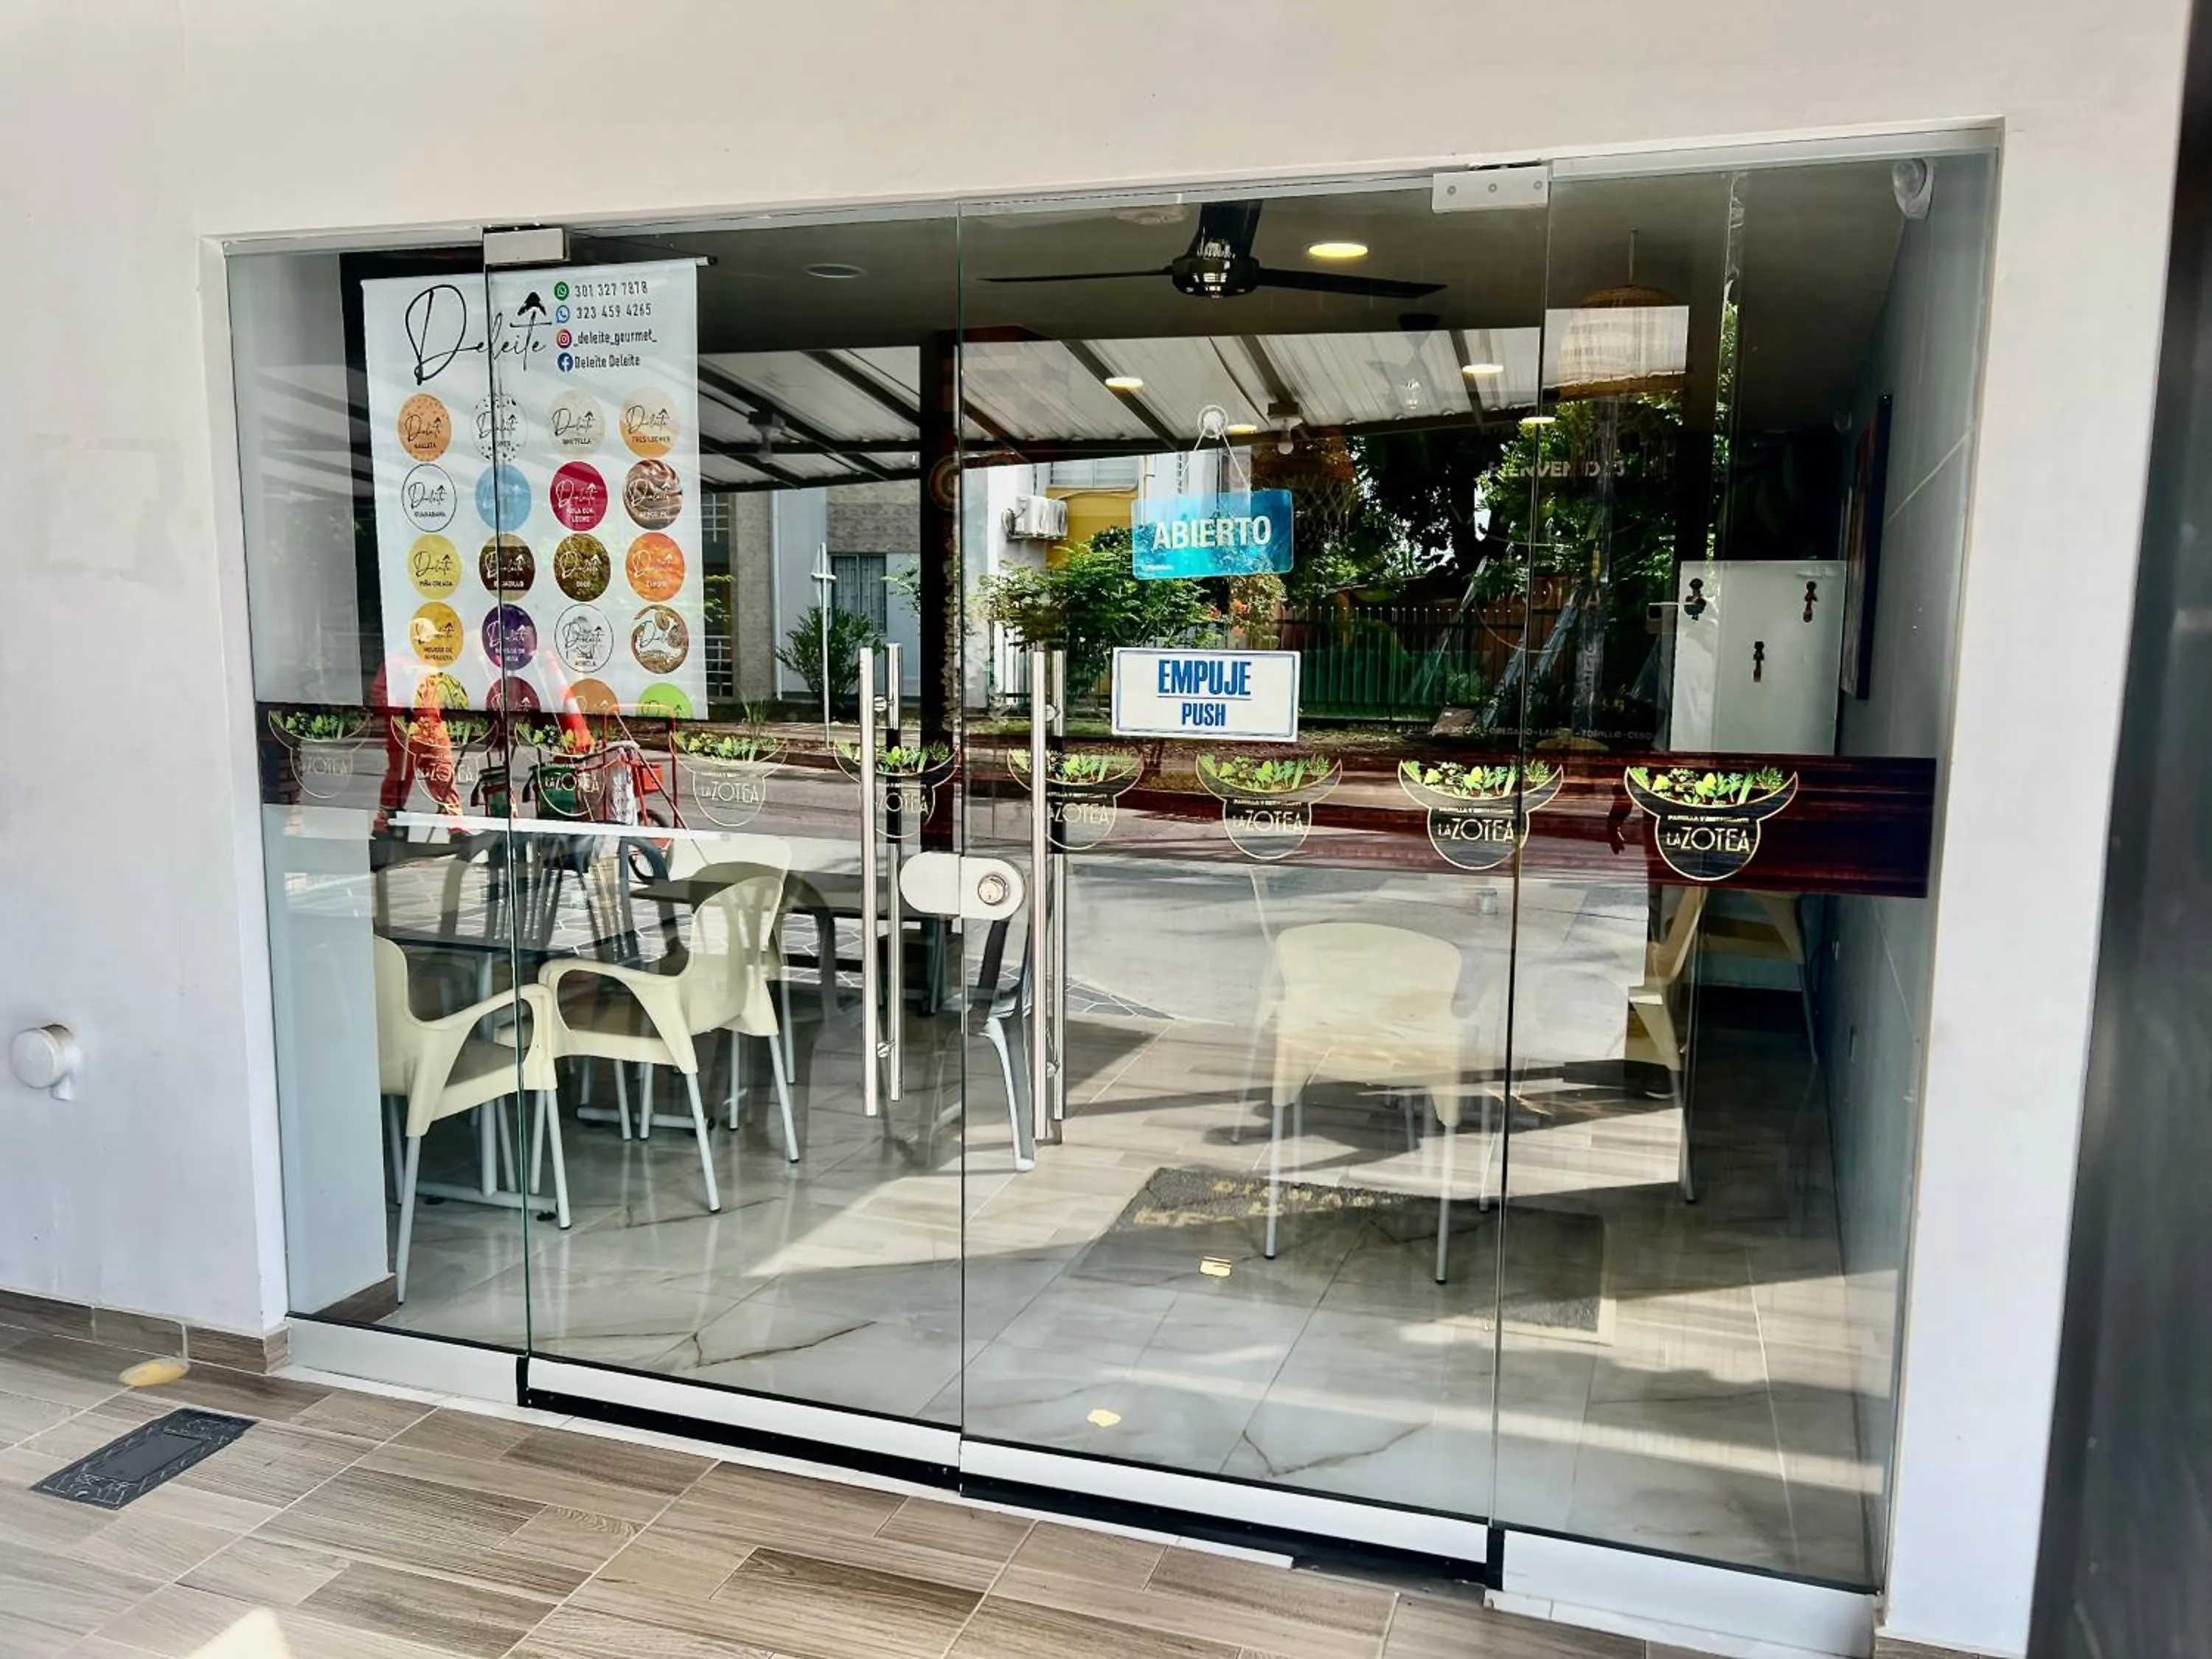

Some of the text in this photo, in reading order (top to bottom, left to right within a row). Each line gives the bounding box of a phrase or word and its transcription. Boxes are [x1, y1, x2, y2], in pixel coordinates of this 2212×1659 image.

[575, 284, 594, 297] 301
[598, 282, 616, 296] 327
[577, 302, 651, 319] 323 459 4265
[406, 284, 552, 386] Deleite
[1152, 515, 1272, 550] ABIERTO
[1158, 658, 1251, 696] EMPUJE
[1181, 703, 1226, 727] PUSH
[712, 781, 759, 803] ZOTEA
[1054, 802, 1110, 824] ZOTEA
[1245, 810, 1304, 833] ZOTEA
[1451, 818, 1514, 842] ZOTEA
[1681, 827, 1750, 852] ZOTEA
